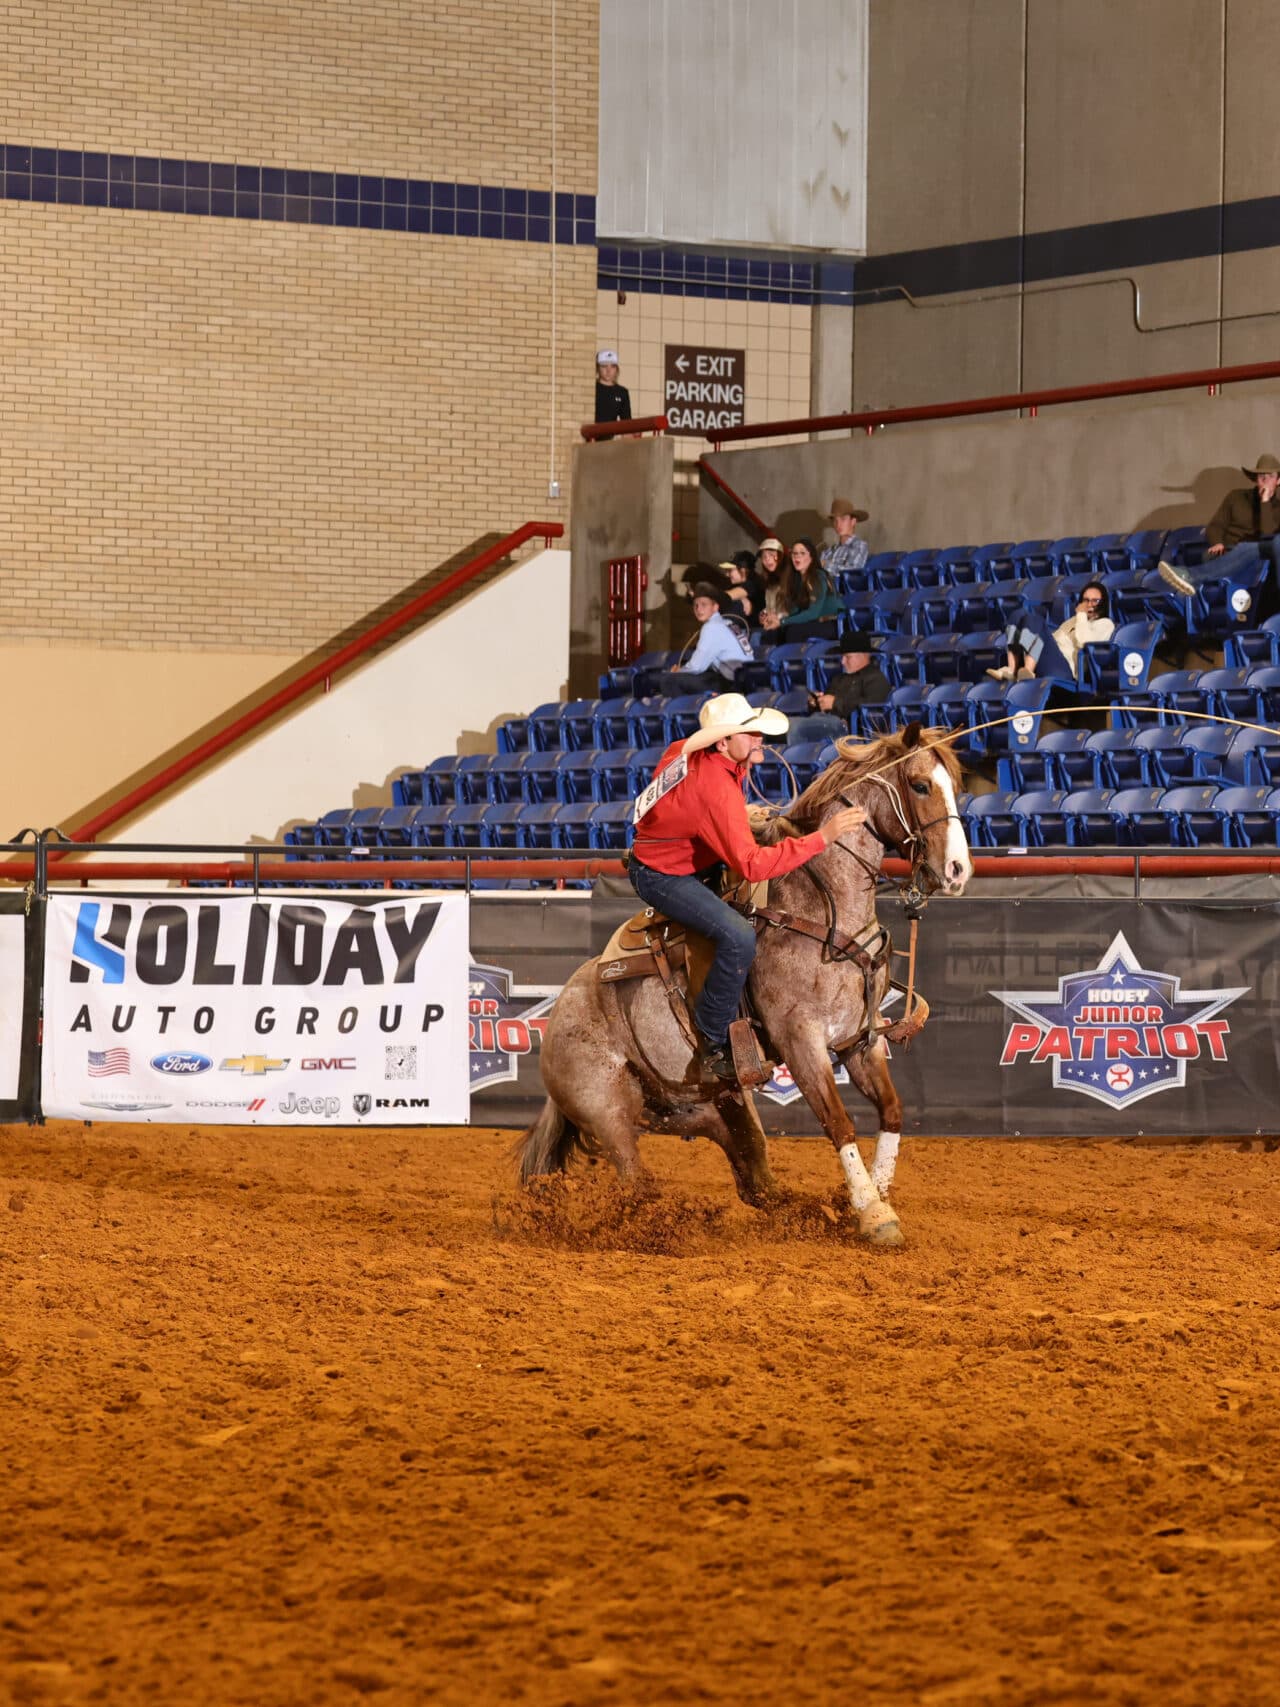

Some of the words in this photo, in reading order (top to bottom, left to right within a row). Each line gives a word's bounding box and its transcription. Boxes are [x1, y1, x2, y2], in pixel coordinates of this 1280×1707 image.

[696, 355, 736, 377] EXIT
[666, 380, 743, 405] PARKING
[666, 408, 742, 429] GARAGE
[70, 902, 442, 985] HOLIDAY
[1087, 988, 1150, 1003] HOOEY
[70, 1004, 215, 1034] AUTO
[255, 1004, 444, 1034] GROUP
[1073, 1005, 1164, 1025] JUNIOR
[999, 1019, 1231, 1065] PATRIOT
[162, 1054, 201, 1072] Ford
[300, 1057, 356, 1071] GMC
[279, 1092, 341, 1118] Jeep
[375, 1098, 430, 1108] RAM
